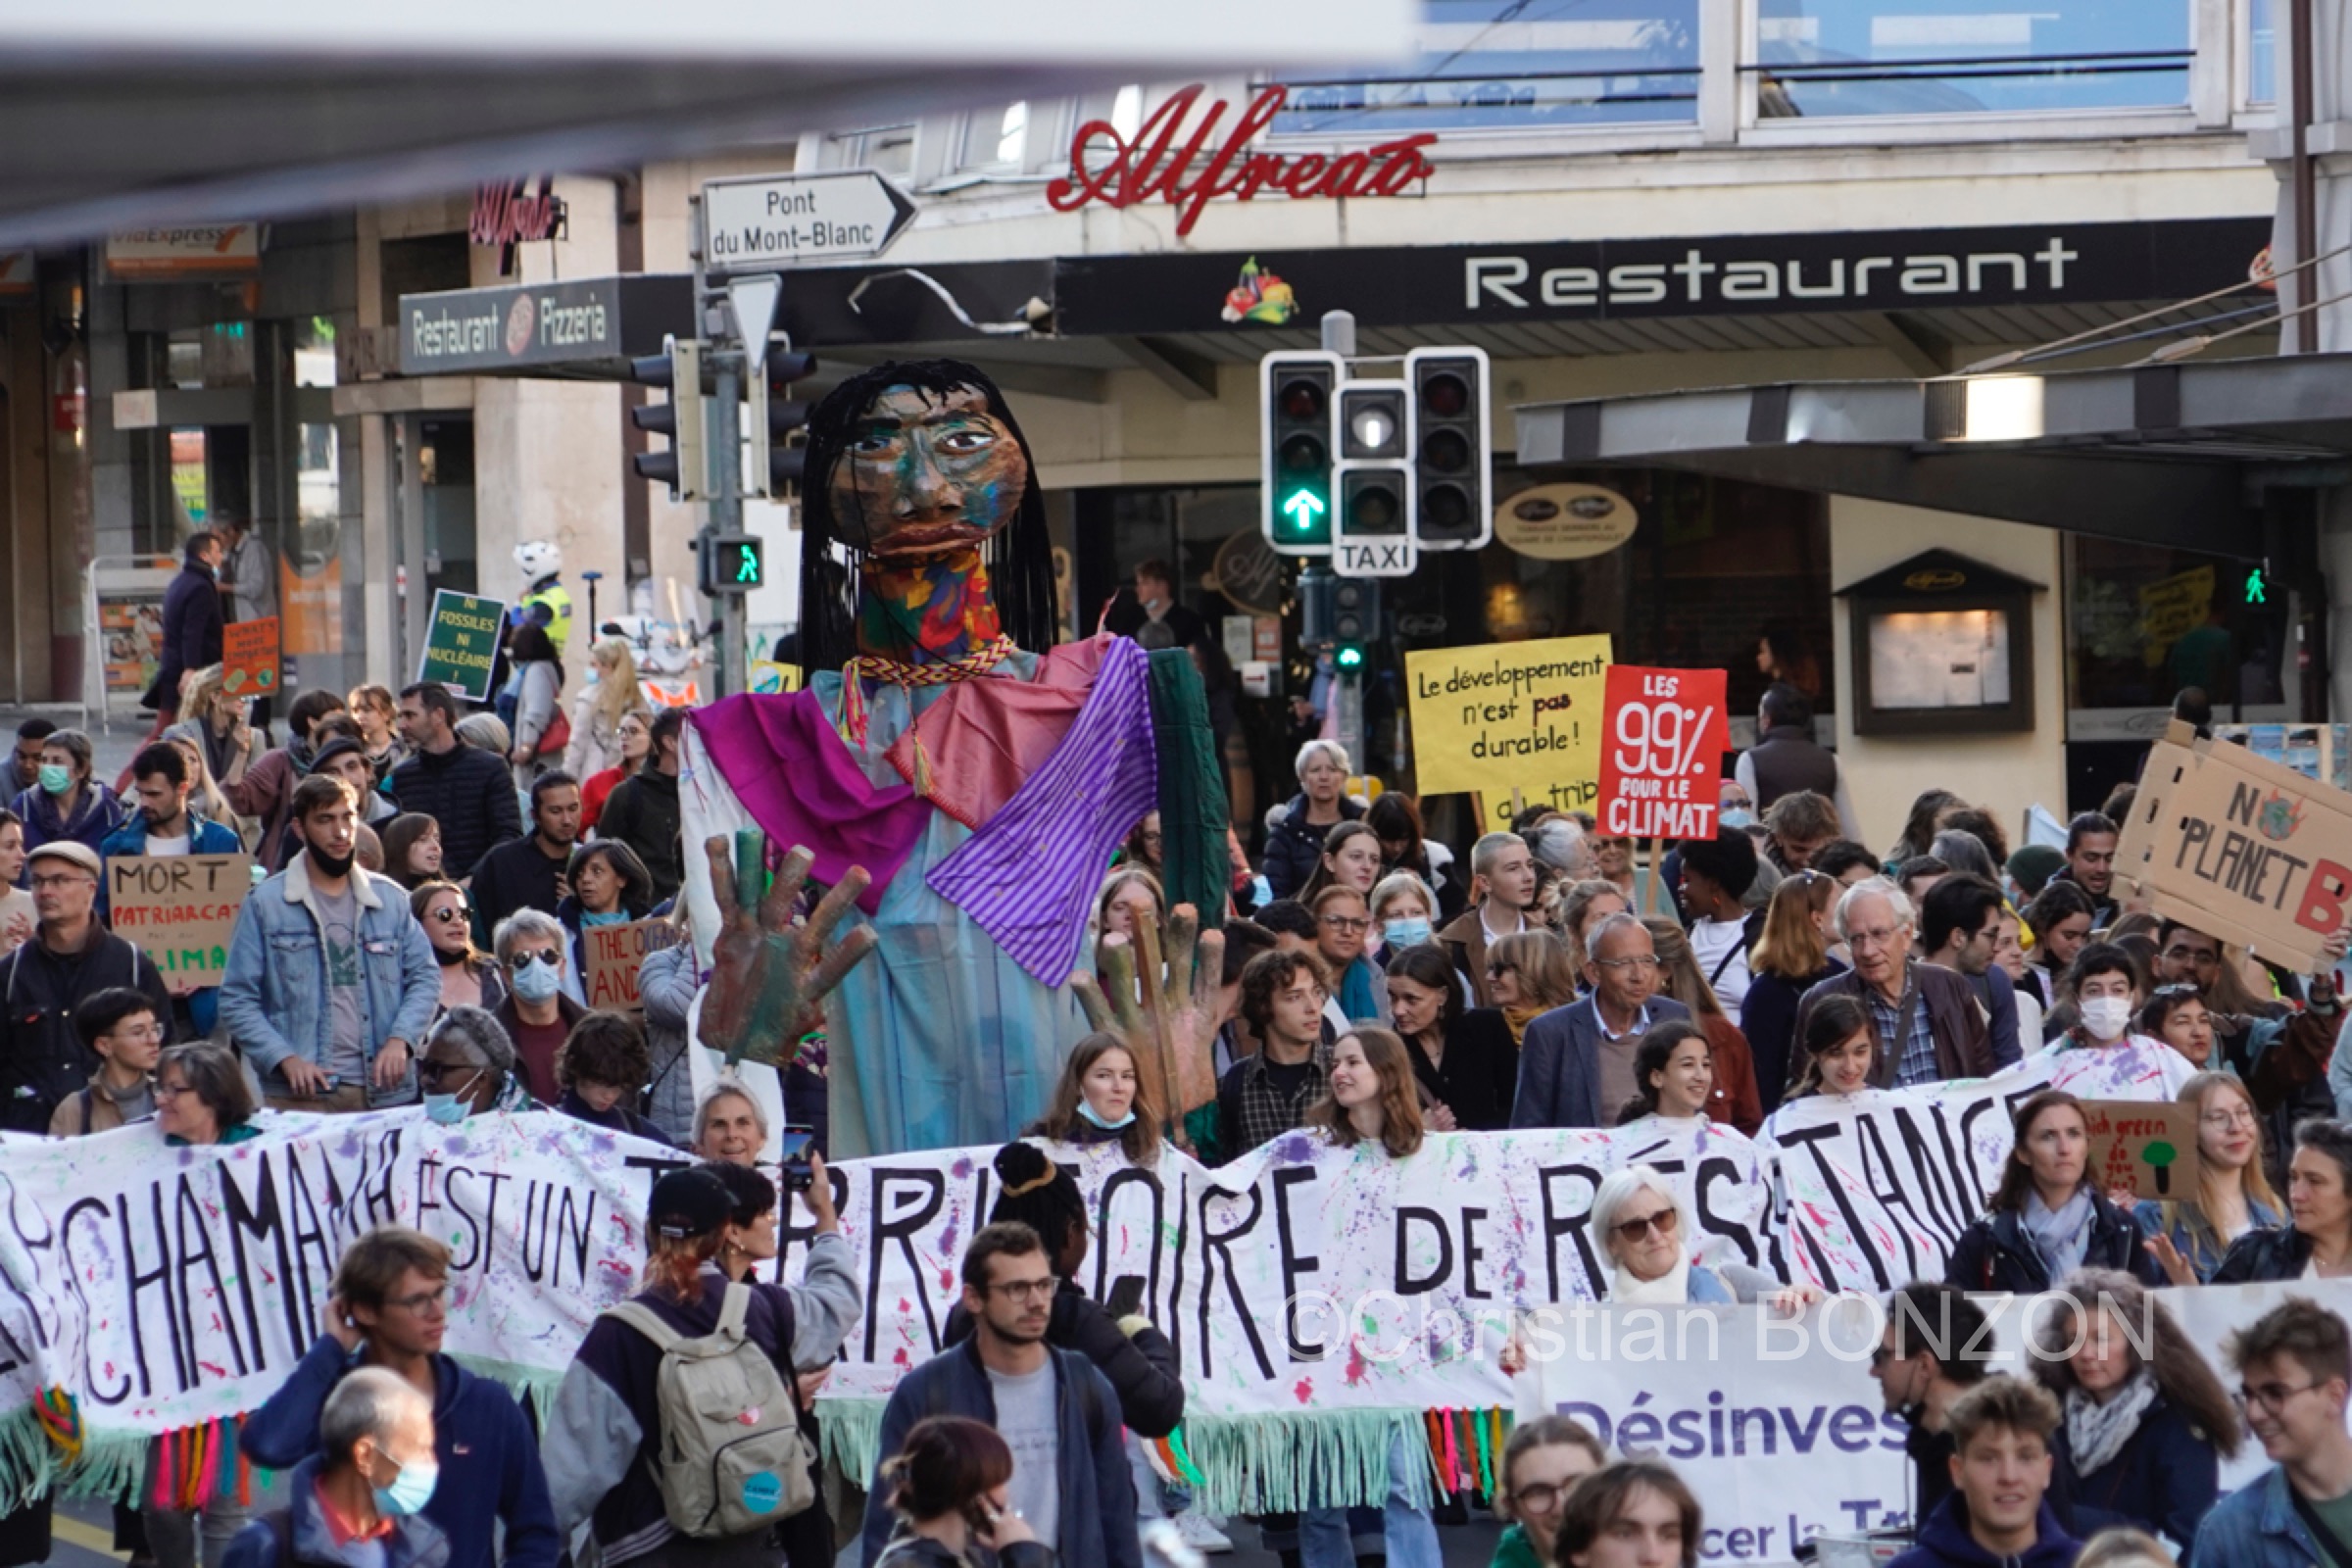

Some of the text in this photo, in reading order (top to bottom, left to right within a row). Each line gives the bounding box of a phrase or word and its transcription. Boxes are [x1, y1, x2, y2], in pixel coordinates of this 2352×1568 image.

[766, 188, 816, 216] Pont
[713, 221, 873, 255] du Mont-Blanc
[1465, 237, 2079, 310] Restaurant
[413, 292, 607, 356] Restaurant Pizzeria
[1341, 545, 1408, 568] TAXI
[438, 611, 496, 633] FOSSILES
[456, 633, 470, 647] NI
[1419, 654, 1604, 699] Le développement
[1643, 674, 1680, 698] LES
[1463, 693, 1572, 728] n'est pas
[1615, 701, 1714, 776] 99%
[1618, 776, 1690, 800] POUR LE
[1608, 797, 1716, 838] CLIMAT
[115, 860, 230, 894] MORT
[2175, 816, 2352, 935] PLANET B
[594, 927, 629, 961] THE
[2116, 1118, 2167, 1145] green
[2109, 1143, 2128, 1161] do
[521, 1180, 596, 1289] UN
[1395, 1206, 1488, 1299] DE
